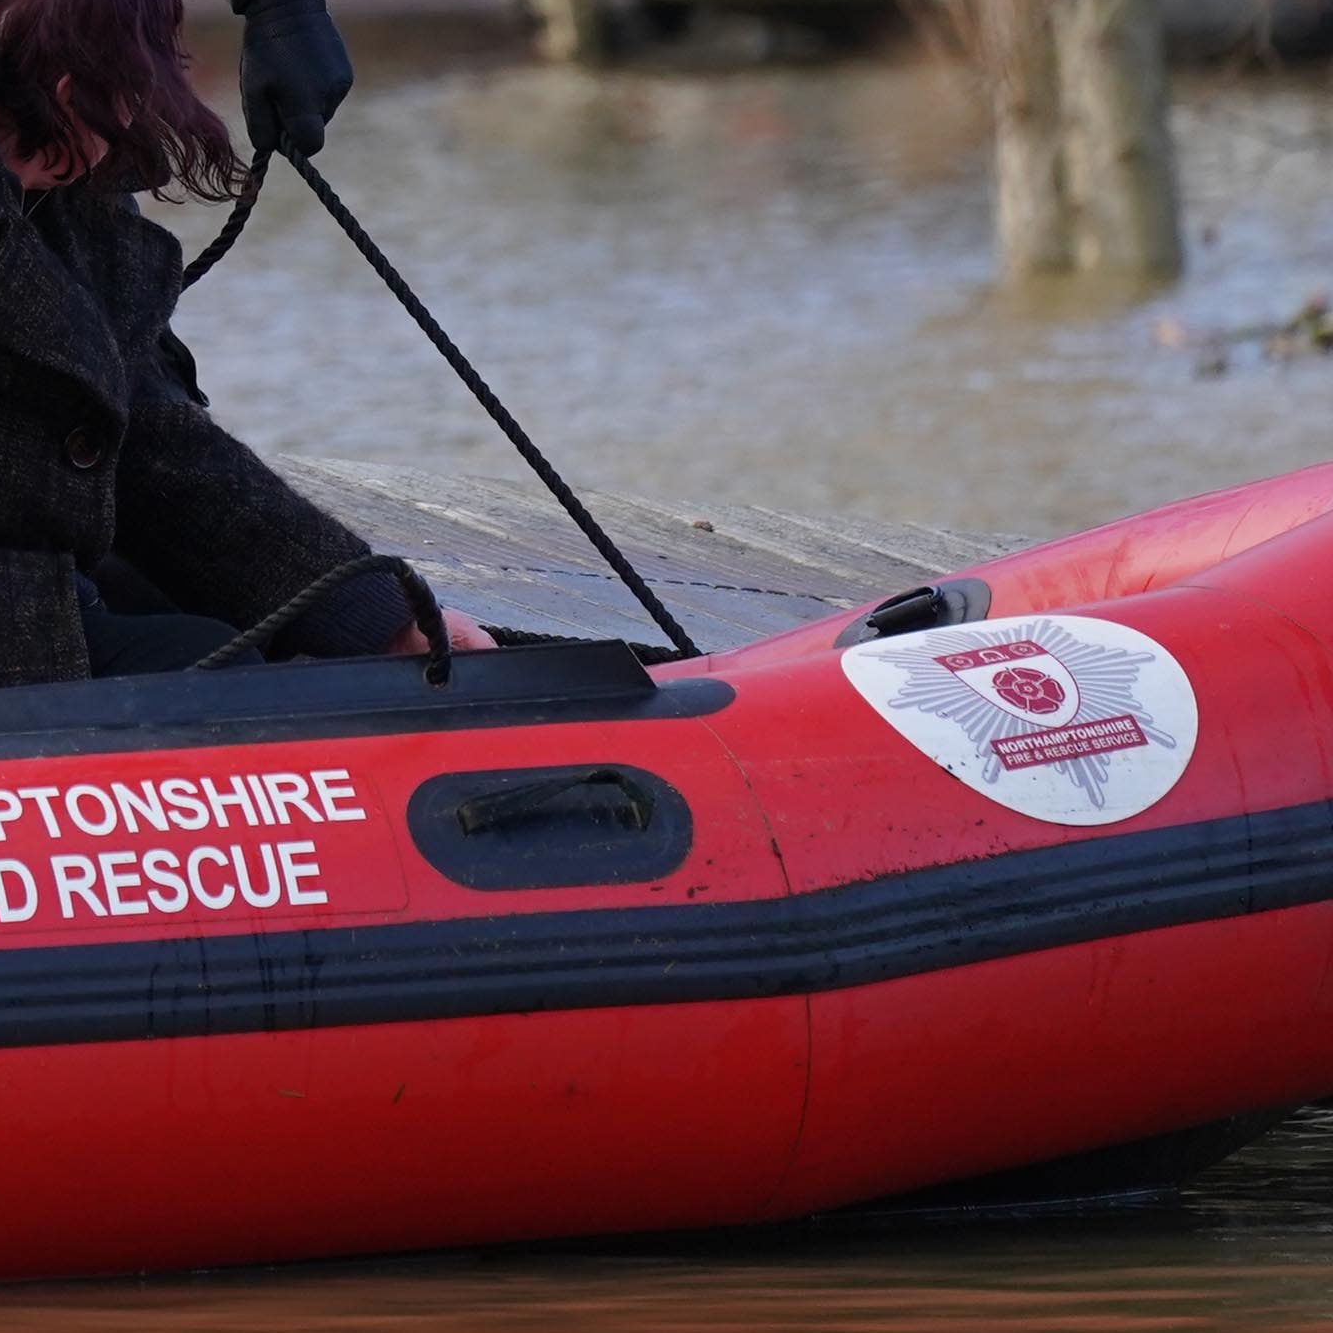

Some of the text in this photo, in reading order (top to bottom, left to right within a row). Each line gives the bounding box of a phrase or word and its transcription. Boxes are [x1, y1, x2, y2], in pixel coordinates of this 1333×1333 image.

[997, 718, 1136, 755] NORTHAMPTONSHIRE
[1006, 731, 1142, 767] FIRE & RESCUE SERVICE
[51, 840, 329, 920] RESCUE
